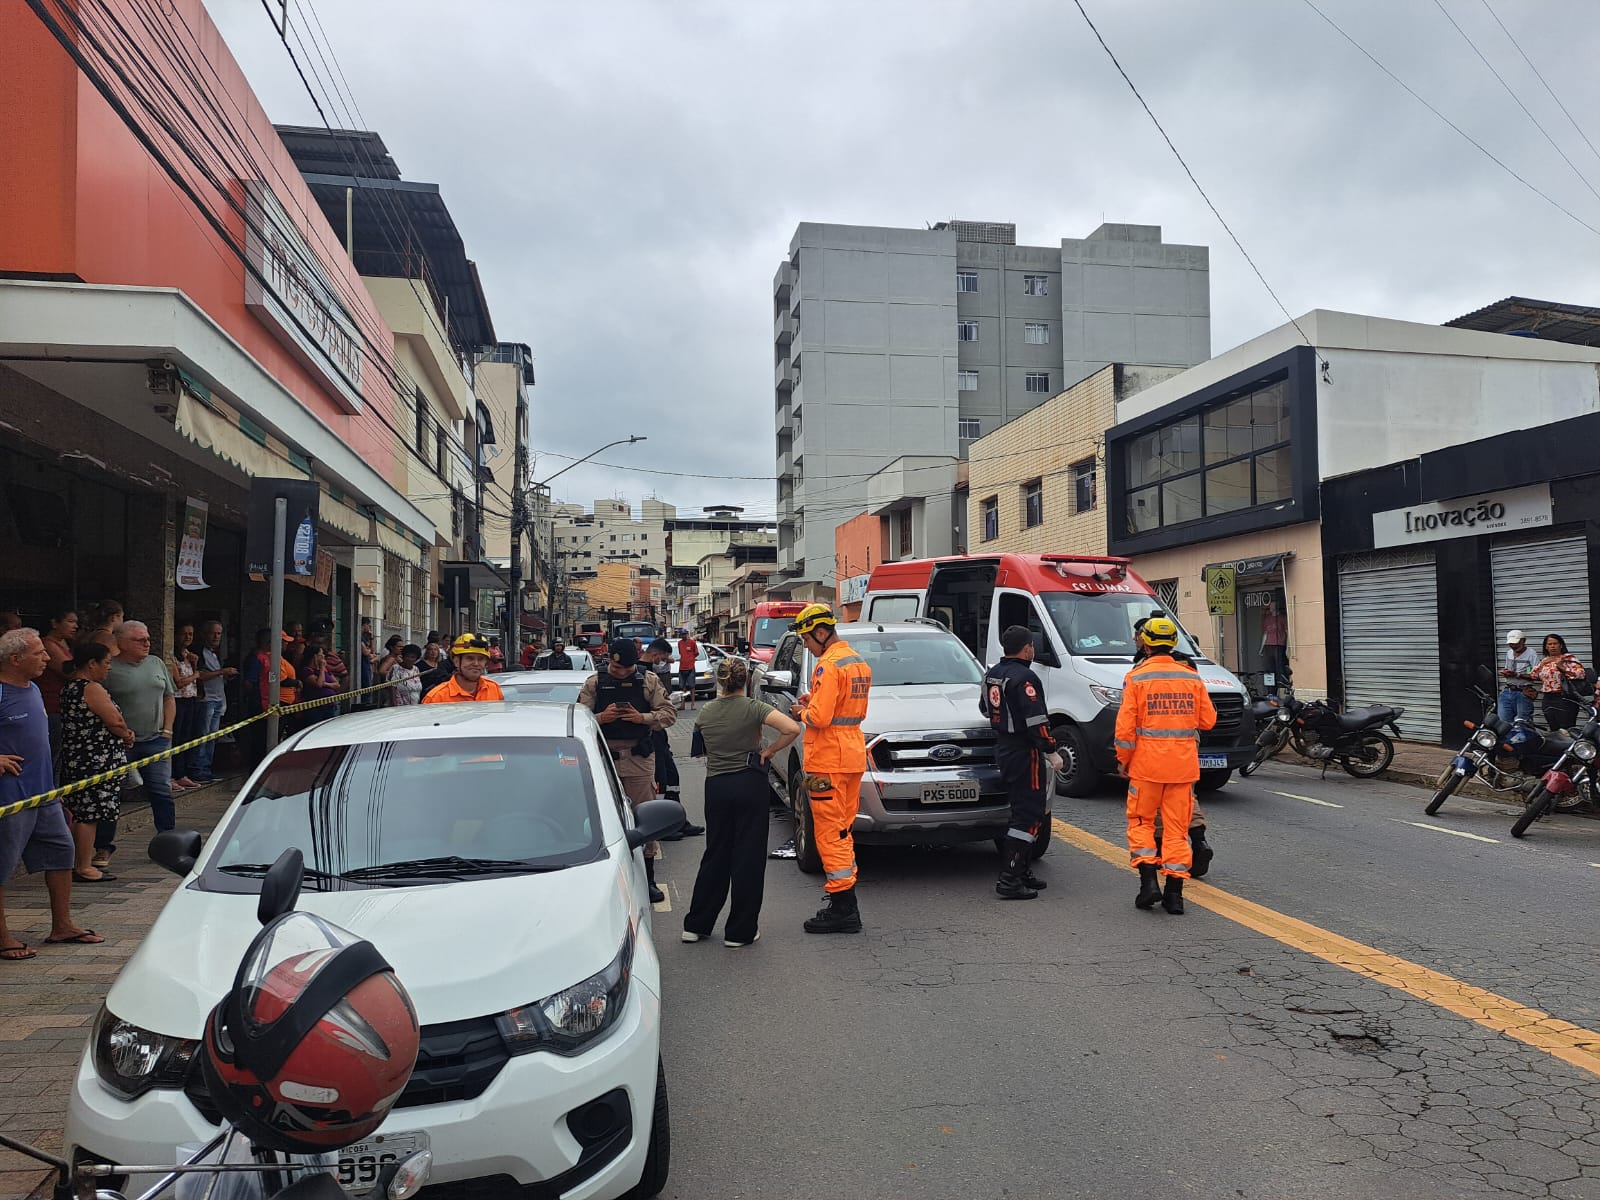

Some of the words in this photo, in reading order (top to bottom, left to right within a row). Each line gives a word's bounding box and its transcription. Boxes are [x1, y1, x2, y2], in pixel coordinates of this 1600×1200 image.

[1404, 500, 1505, 533] Inovação
[1148, 700, 1194, 710] MILITAR
[937, 748, 956, 757] Ford
